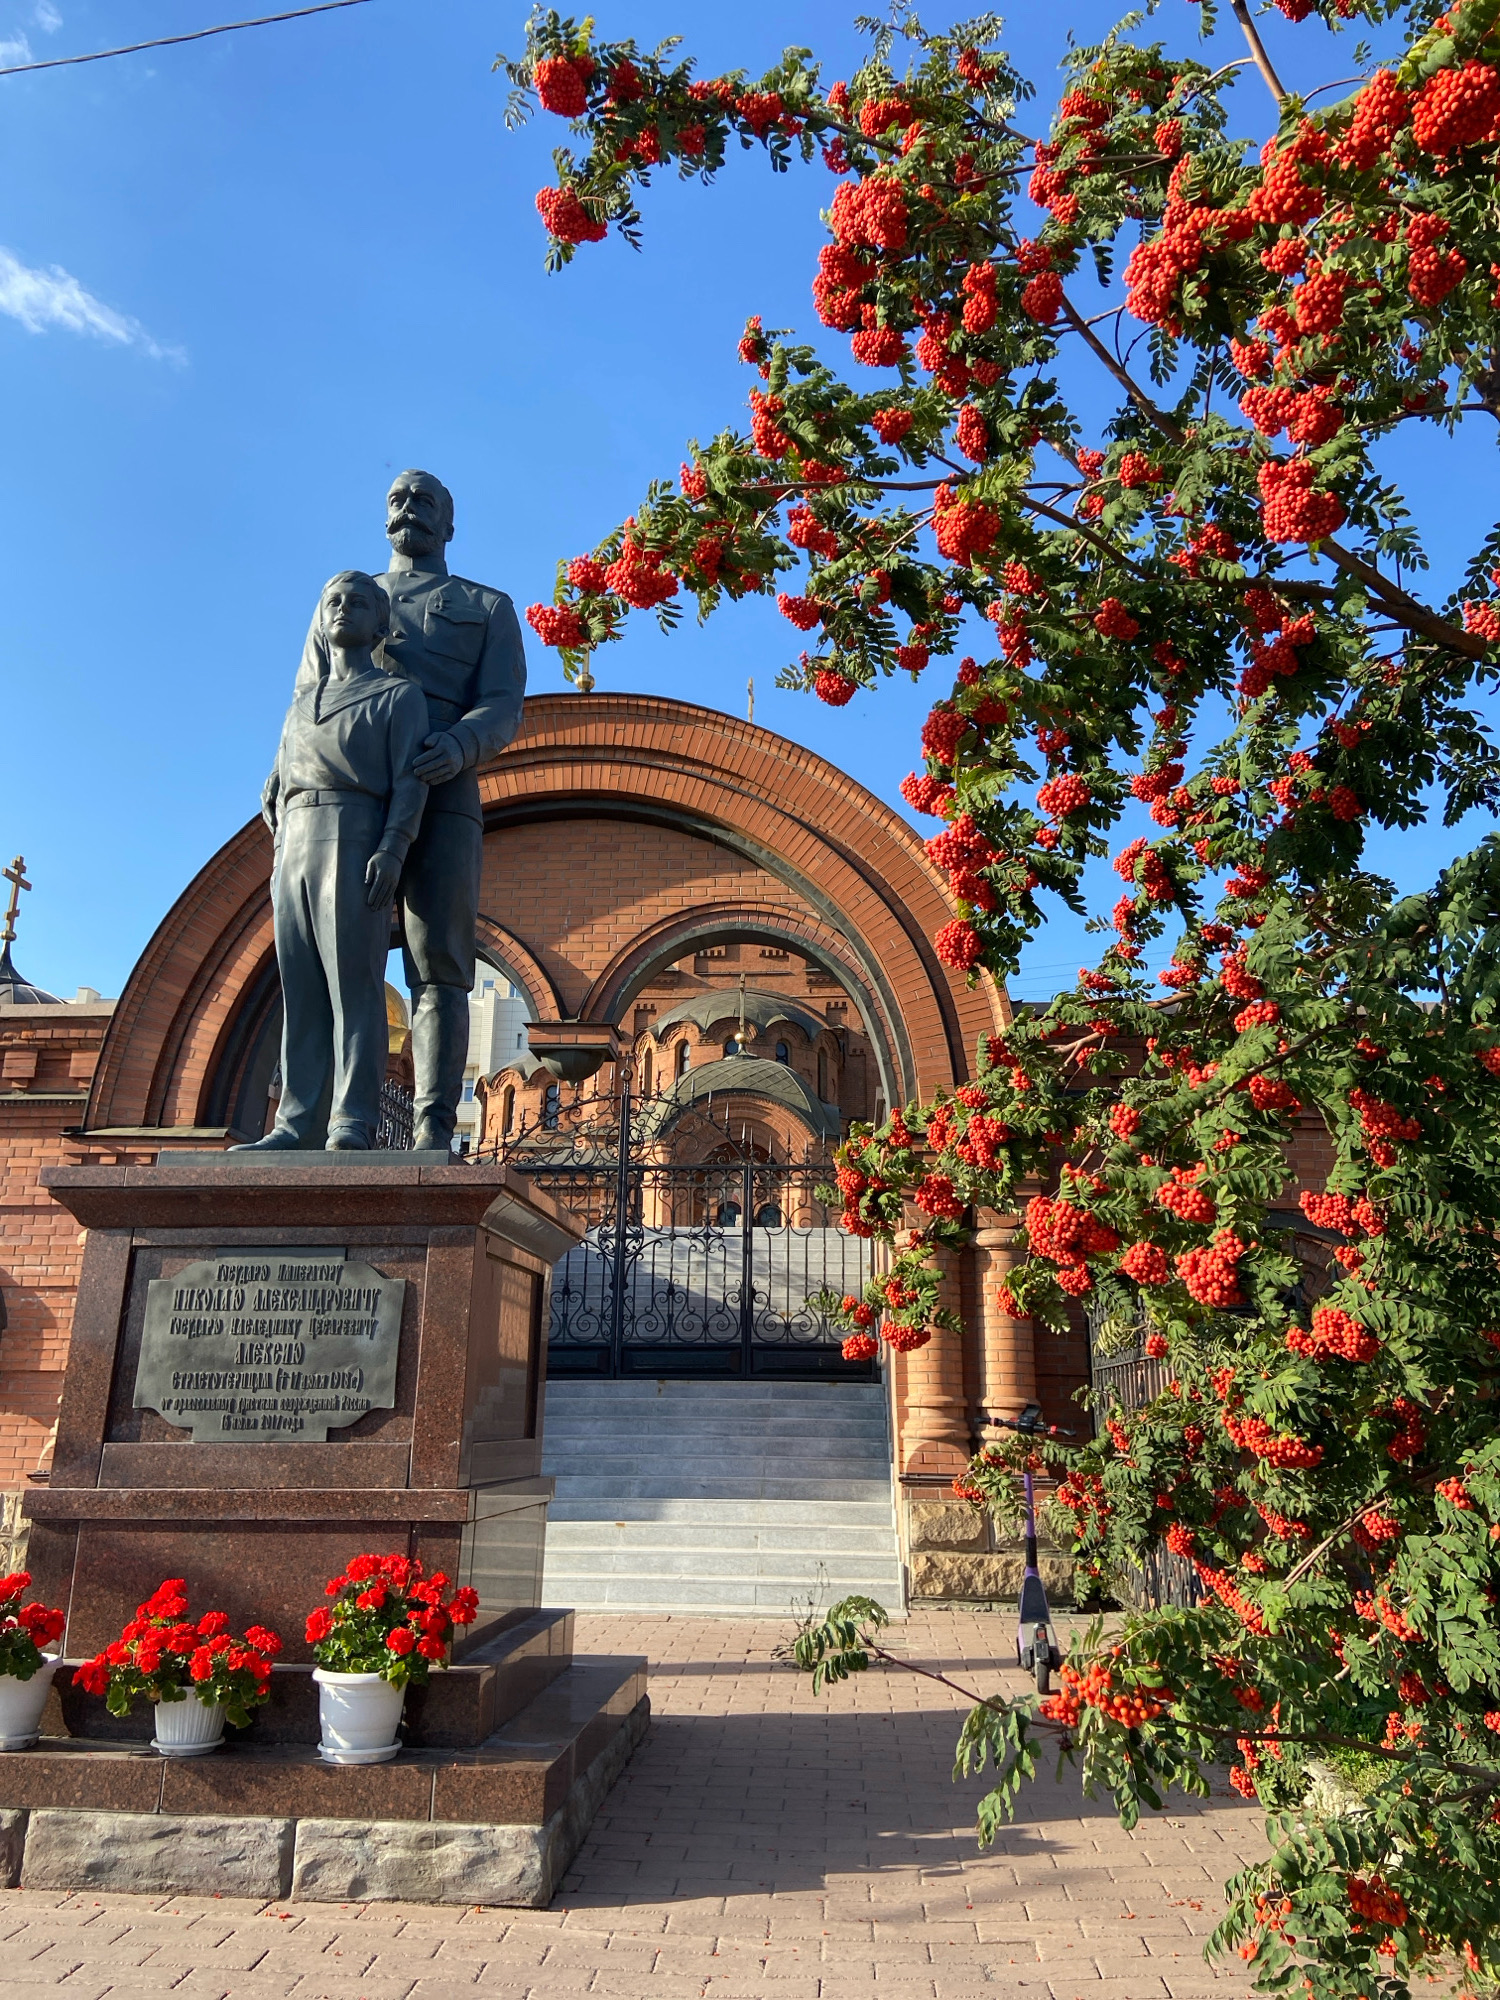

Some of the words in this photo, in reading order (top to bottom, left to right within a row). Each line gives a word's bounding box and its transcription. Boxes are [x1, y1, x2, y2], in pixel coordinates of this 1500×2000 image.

[217, 1264, 271, 1285] ГОСУДАРЮ
[277, 1264, 344, 1286] ИМПЕРАТОРУ
[173, 1288, 246, 1311] НИКОЛАЮ
[253, 1288, 382, 1317] АЛЕКСАНДРОВИЧУ
[169, 1317, 225, 1339] ГОСУДАРЮ
[230, 1318, 303, 1339] НАСЛЕДНИКУ
[308, 1318, 379, 1340] ЦЕСАРЕВИЧУ
